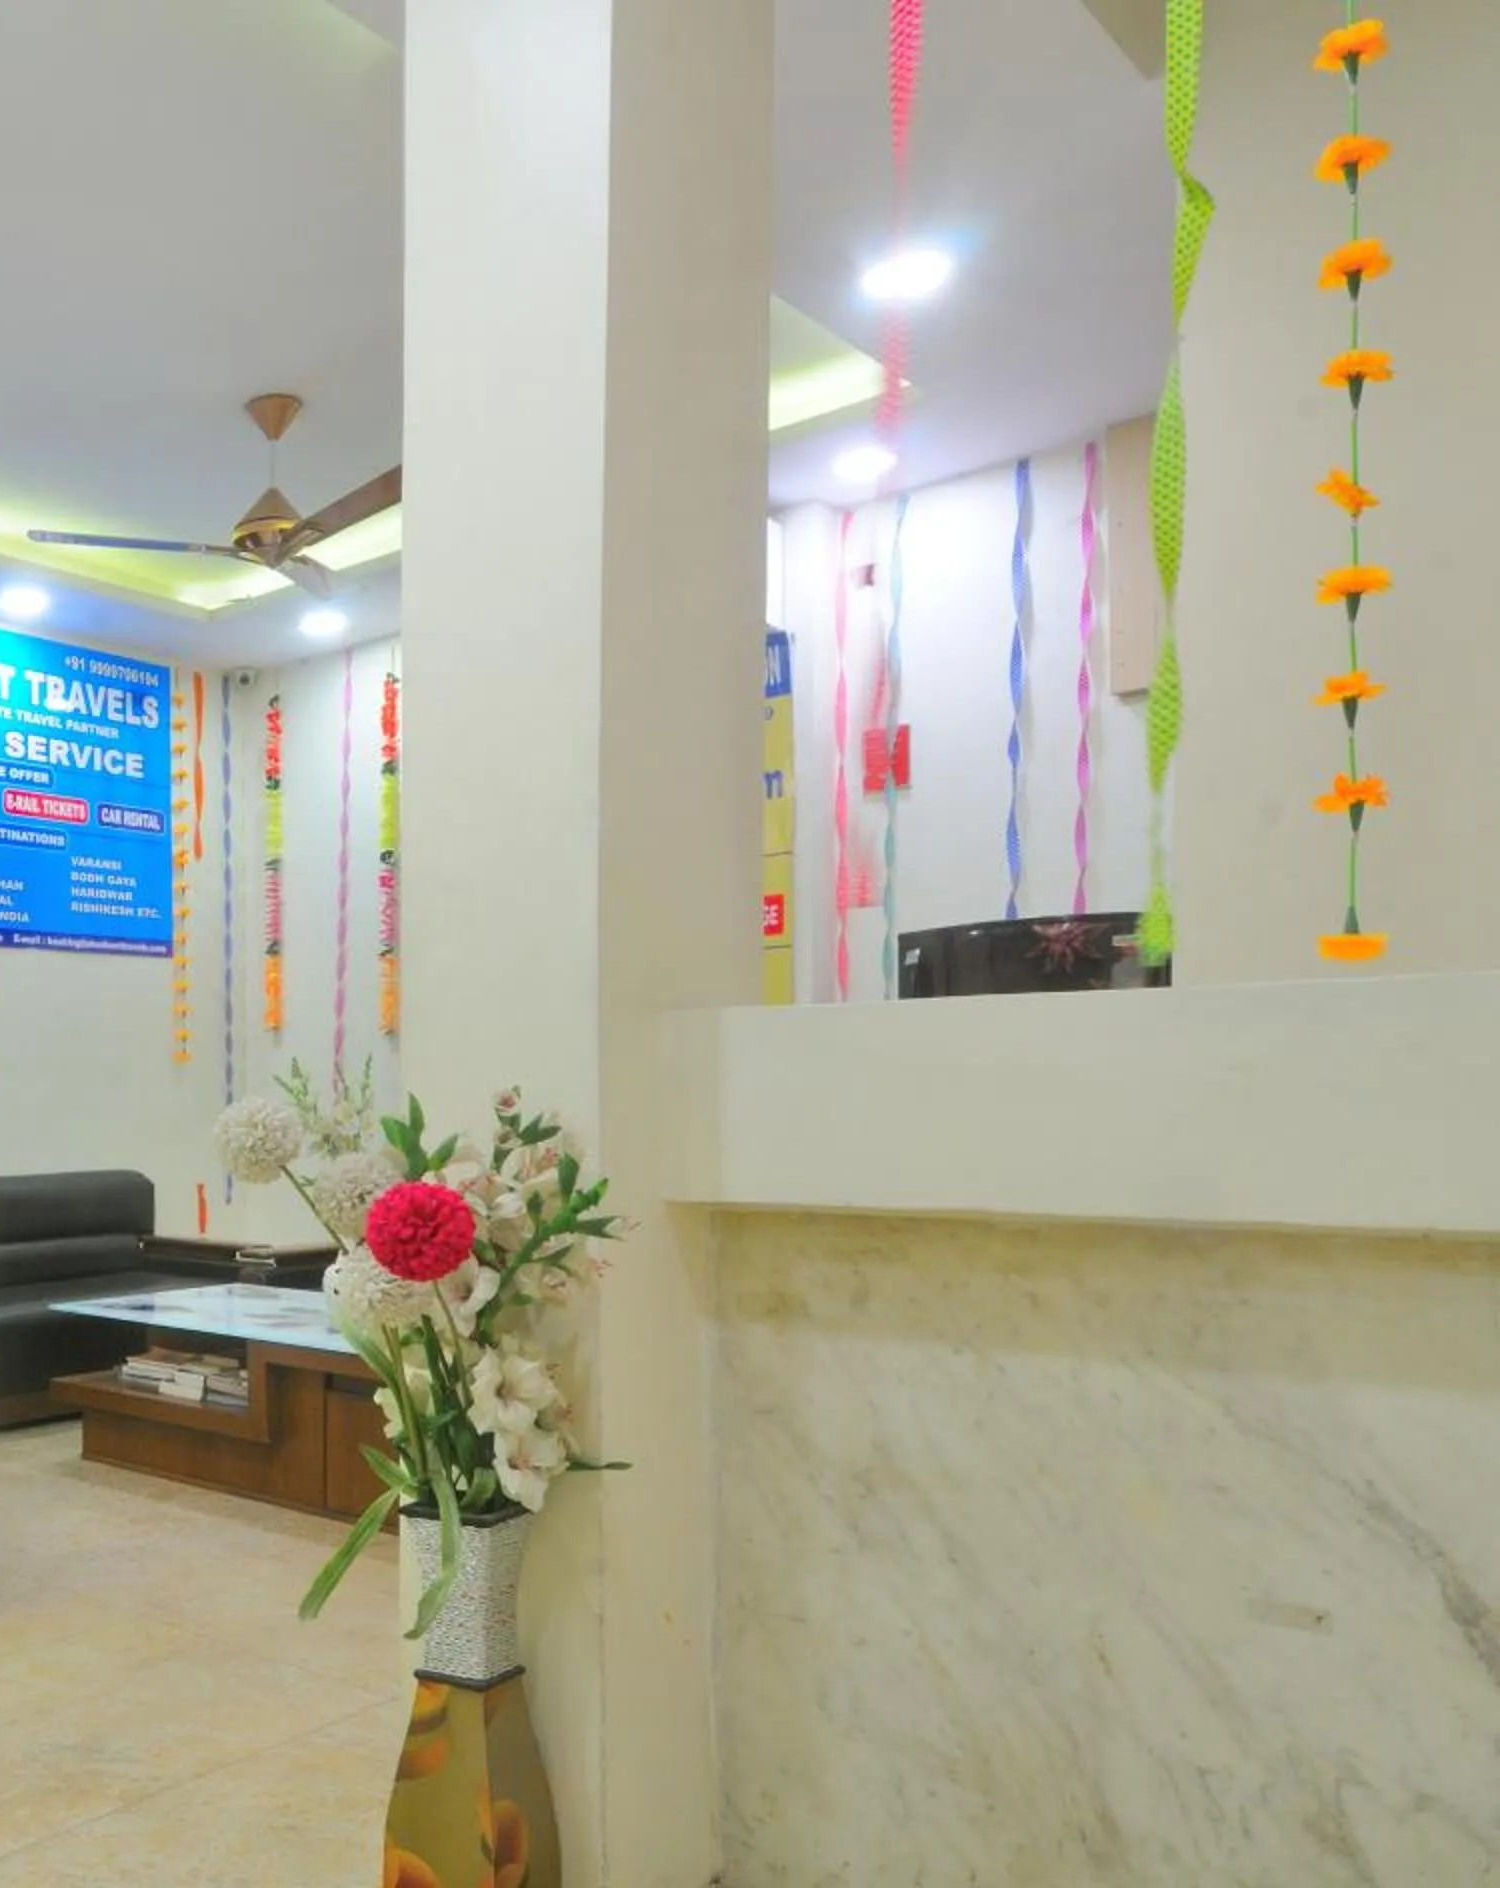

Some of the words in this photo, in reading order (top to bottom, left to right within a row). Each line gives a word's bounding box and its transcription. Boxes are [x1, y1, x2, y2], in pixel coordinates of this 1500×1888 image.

[25, 669, 159, 729] TRAVELS
[16, 709, 62, 728] TRAVEL
[66, 719, 119, 739] PARTNER
[5, 731, 145, 777] SERVICE
[9, 768, 49, 783] OFFER
[41, 799, 86, 820] TICKETS
[101, 808, 122, 824] CAR
[123, 811, 160, 830] RENTAL
